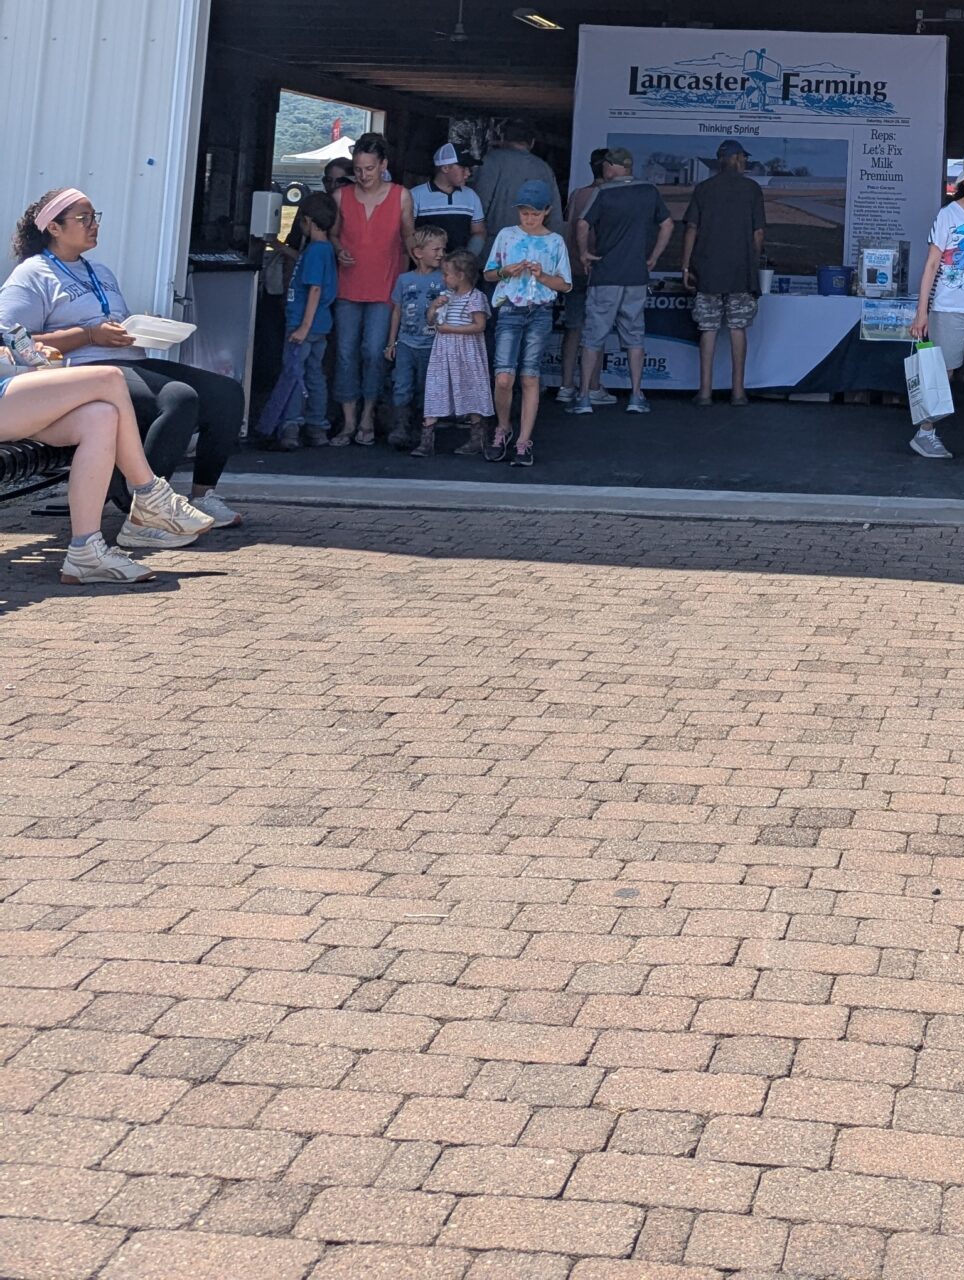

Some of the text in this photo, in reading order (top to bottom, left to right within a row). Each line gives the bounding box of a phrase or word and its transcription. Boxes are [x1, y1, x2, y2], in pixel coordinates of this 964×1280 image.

[629, 66, 888, 102] Lancaster Farming
[698, 124, 760, 136] Thinking Spring
[870, 129, 897, 142] Reps:
[862, 144, 903, 156] Let's Fix
[871, 157, 894, 168] Milk
[859, 169, 904, 182] Premium
[644, 297, 695, 309] HOICE
[602, 353, 666, 371] Faring
